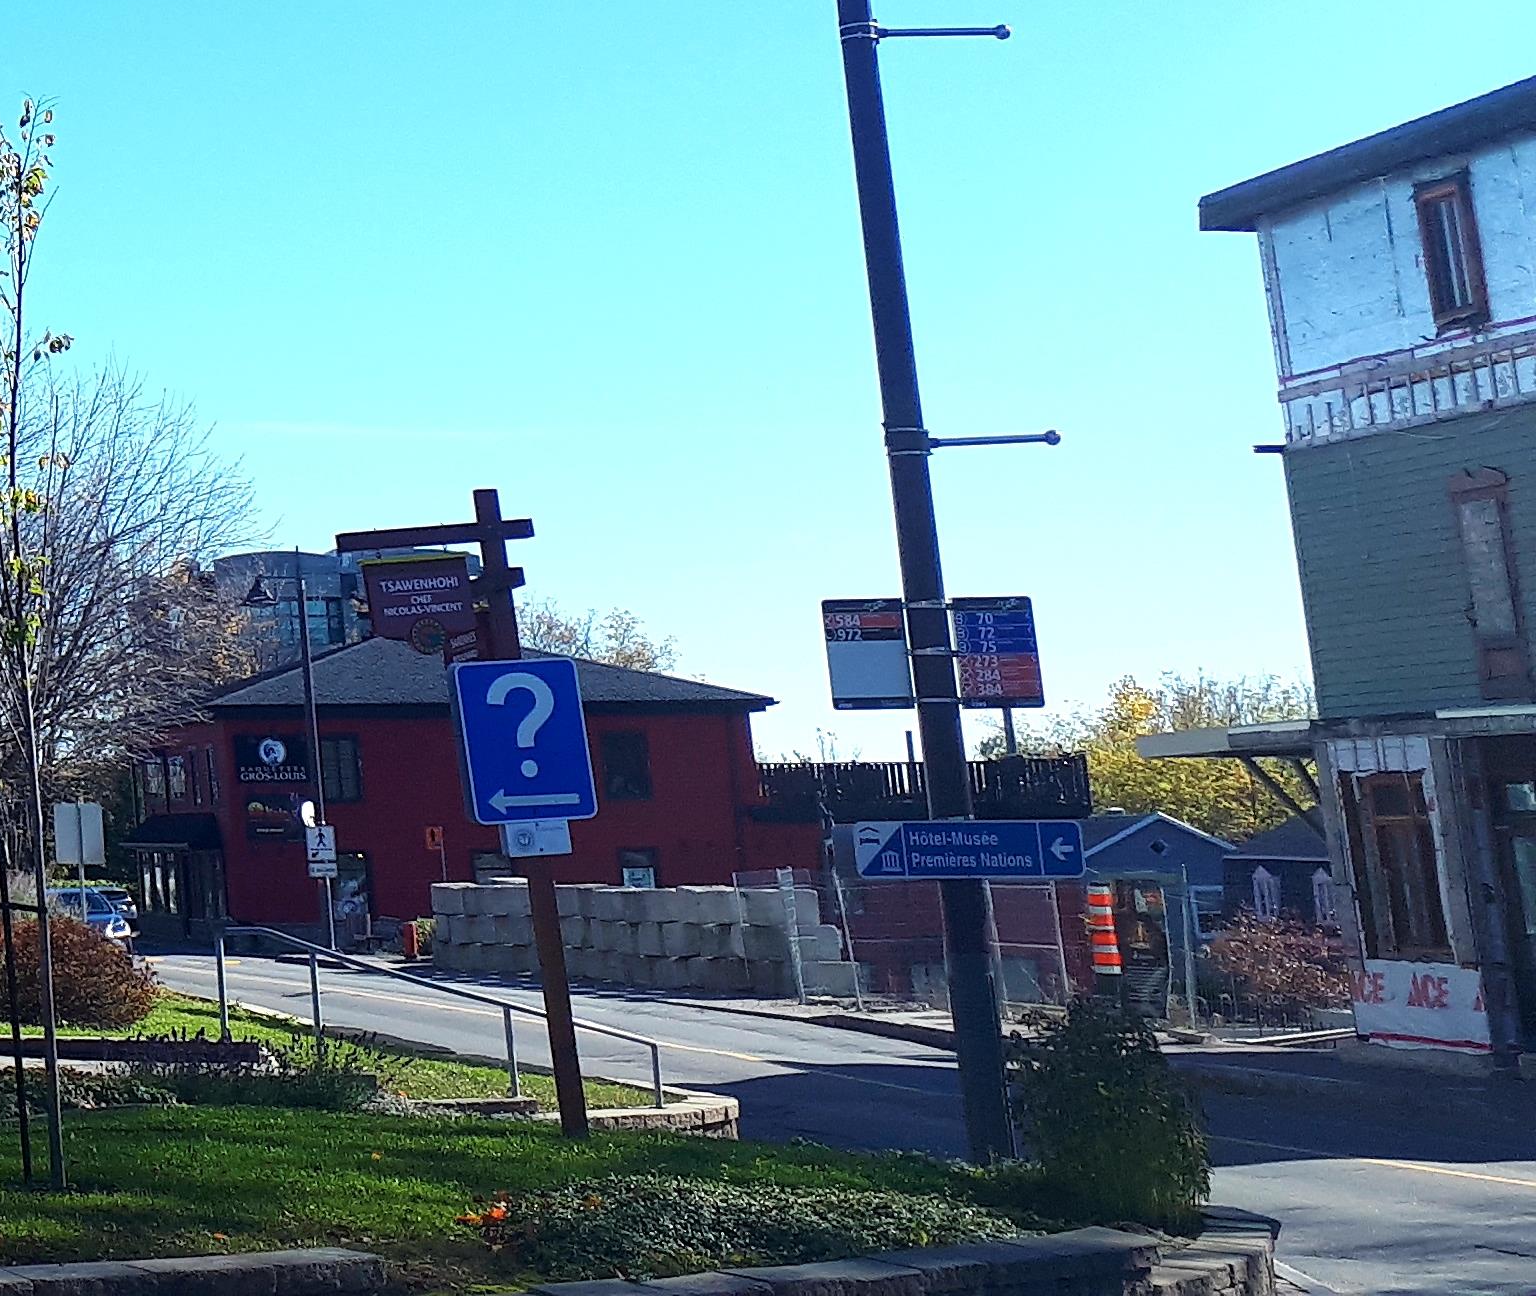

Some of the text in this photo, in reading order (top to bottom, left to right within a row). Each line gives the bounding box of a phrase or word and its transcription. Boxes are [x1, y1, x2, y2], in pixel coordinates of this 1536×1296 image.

[380, 576, 459, 593] TSAWENHOHI
[835, 614, 861, 627] 584
[976, 613, 994, 625] 70
[837, 629, 863, 641] 972
[979, 627, 995, 640] 72
[980, 641, 997, 653] 75
[975, 655, 999, 667] 273
[976, 669, 1001, 681] 284
[977, 683, 1003, 695] 384
[240, 772, 306, 780] GROS-LOUIS
[909, 831, 999, 846] Hôtel-Musée
[911, 853, 1033, 868] Premières Nations
